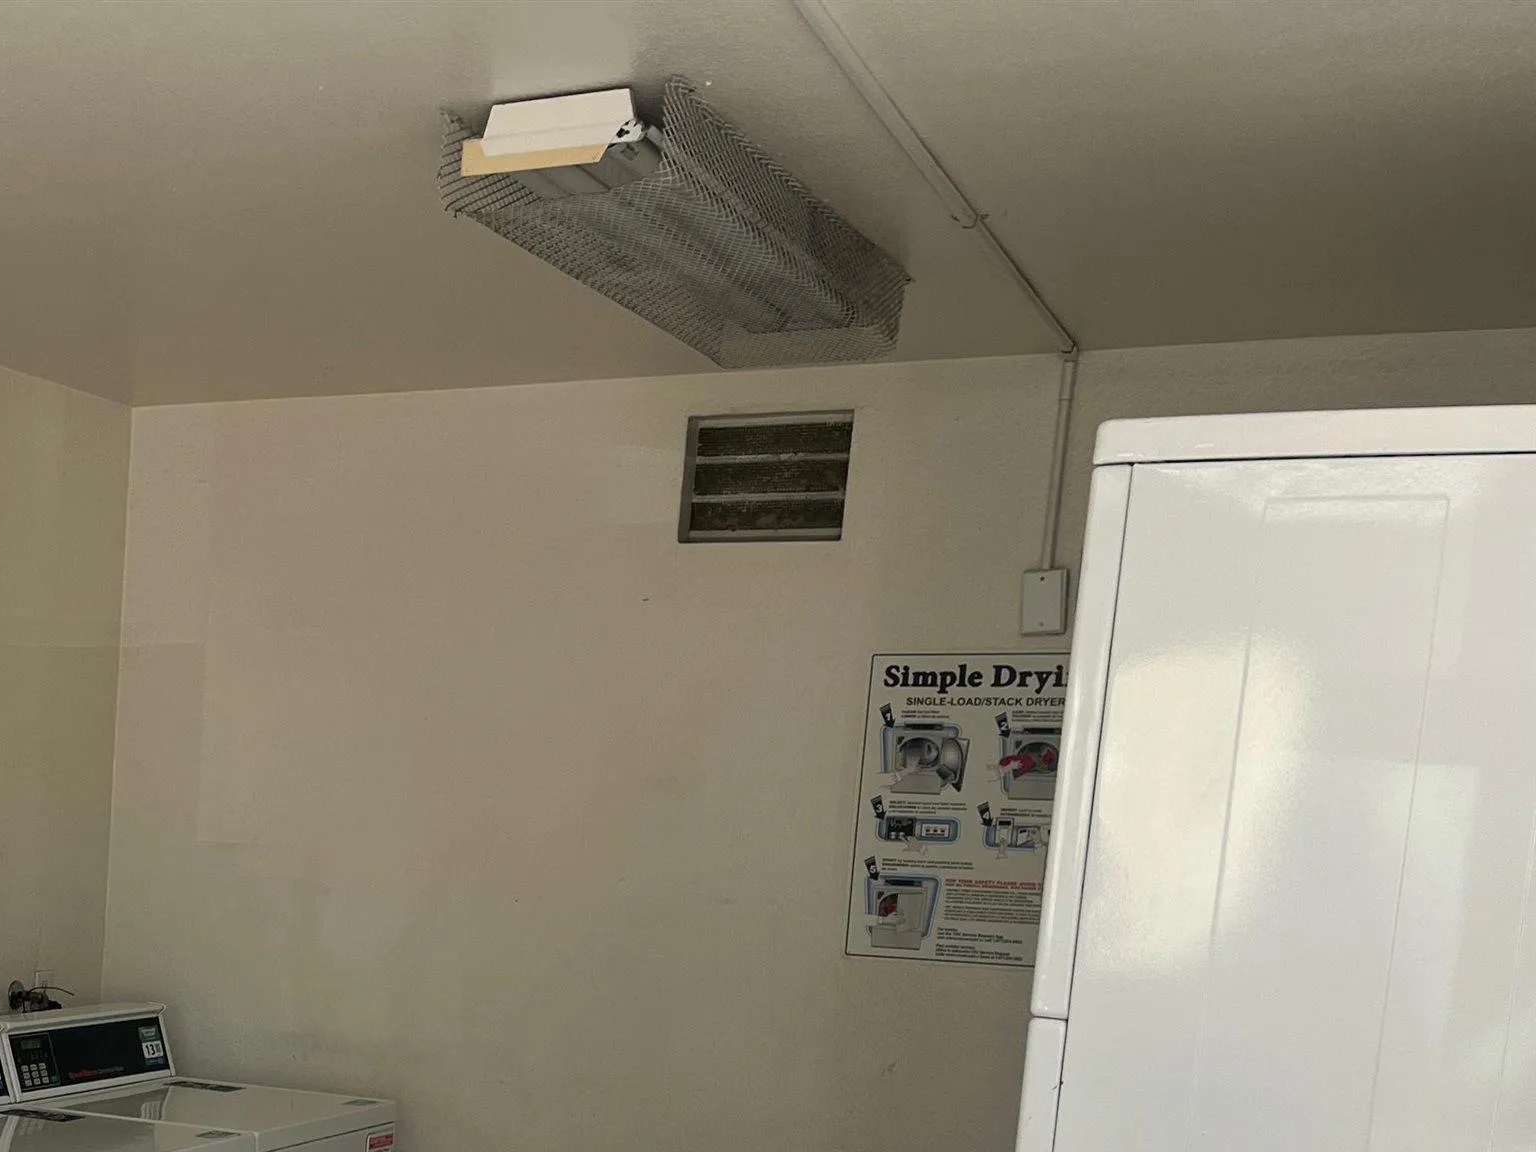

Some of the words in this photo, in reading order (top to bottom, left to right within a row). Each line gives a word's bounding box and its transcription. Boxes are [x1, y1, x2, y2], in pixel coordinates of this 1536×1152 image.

[884, 664, 983, 694] Simple
[991, 664, 1069, 694] Dryi
[906, 697, 1023, 707] SINGLE-LOAD/STACK
[1026, 697, 1066, 707] DRYER
